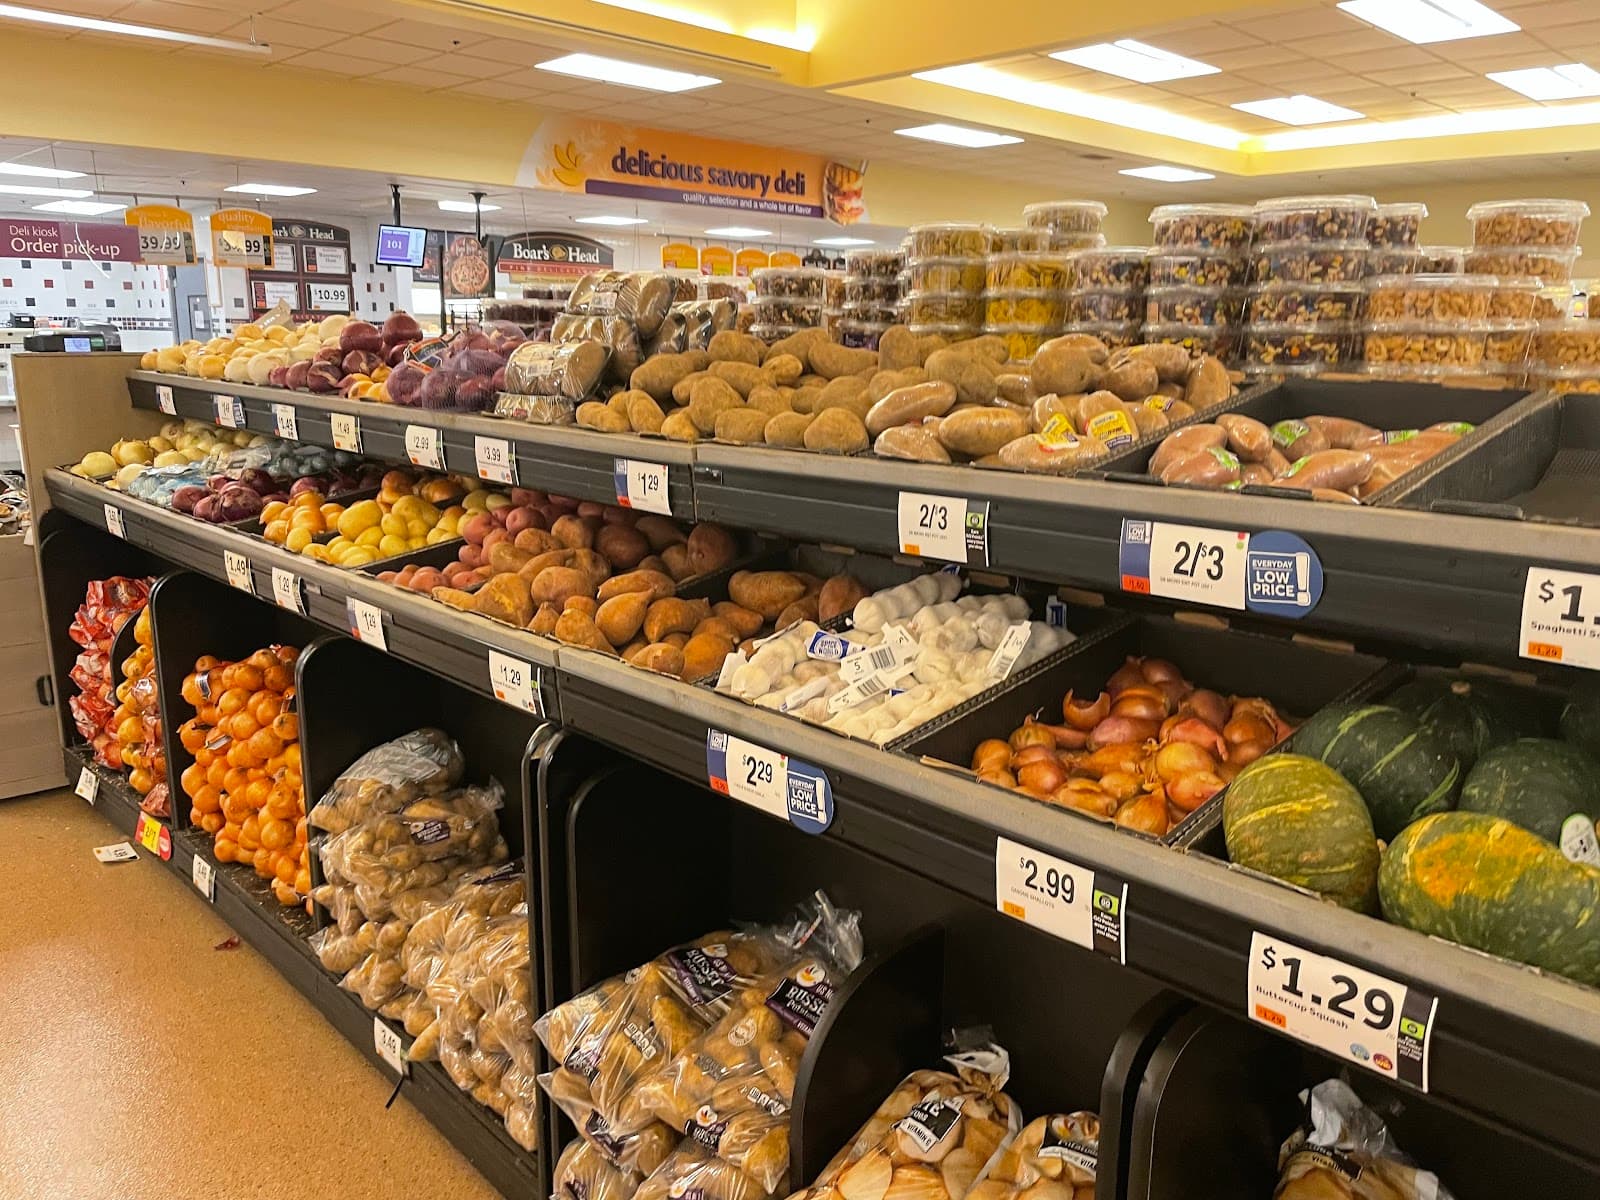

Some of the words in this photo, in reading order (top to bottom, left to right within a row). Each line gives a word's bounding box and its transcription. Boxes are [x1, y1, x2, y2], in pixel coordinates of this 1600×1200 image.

[611, 146, 704, 183] delicious
[707, 167, 771, 197] savory
[774, 168, 806, 196] deli
[682, 192, 708, 204] quality,
[708, 195, 739, 207] selection
[739, 198, 752, 209] and
[759, 200, 778, 211] whole
[779, 202, 787, 212] lot
[787, 203, 795, 212] of
[795, 204, 812, 215] flavor
[9, 225, 29, 236] Deli
[32, 226, 58, 237] kiosk
[309, 228, 335, 240] Head
[11, 237, 59, 253] Order
[63, 239, 120, 259] pick-up
[512, 242, 550, 261] Boar's
[568, 246, 601, 264] Head
[314, 289, 346, 301] $10.99
[1173, 541, 1224, 581] 2/$3
[1252, 559, 1293, 569] EVERYDAY
[1256, 570, 1290, 585] LOW
[1252, 582, 1295, 598] PRICE
[1531, 620, 1587, 636] Spaghetti
[789, 778, 815, 790] EVERYDAY
[792, 788, 813, 803] LOW
[790, 797, 817, 815] PRICE
[1020, 856, 1075, 904] $2.99
[1261, 946, 1395, 1030] $1.29
[785, 985, 828, 1015] RUSSE
[1256, 985, 1308, 1013] Buttercup
[1309, 1007, 1349, 1030] Squash
[906, 1122, 926, 1142] VITAMIN
